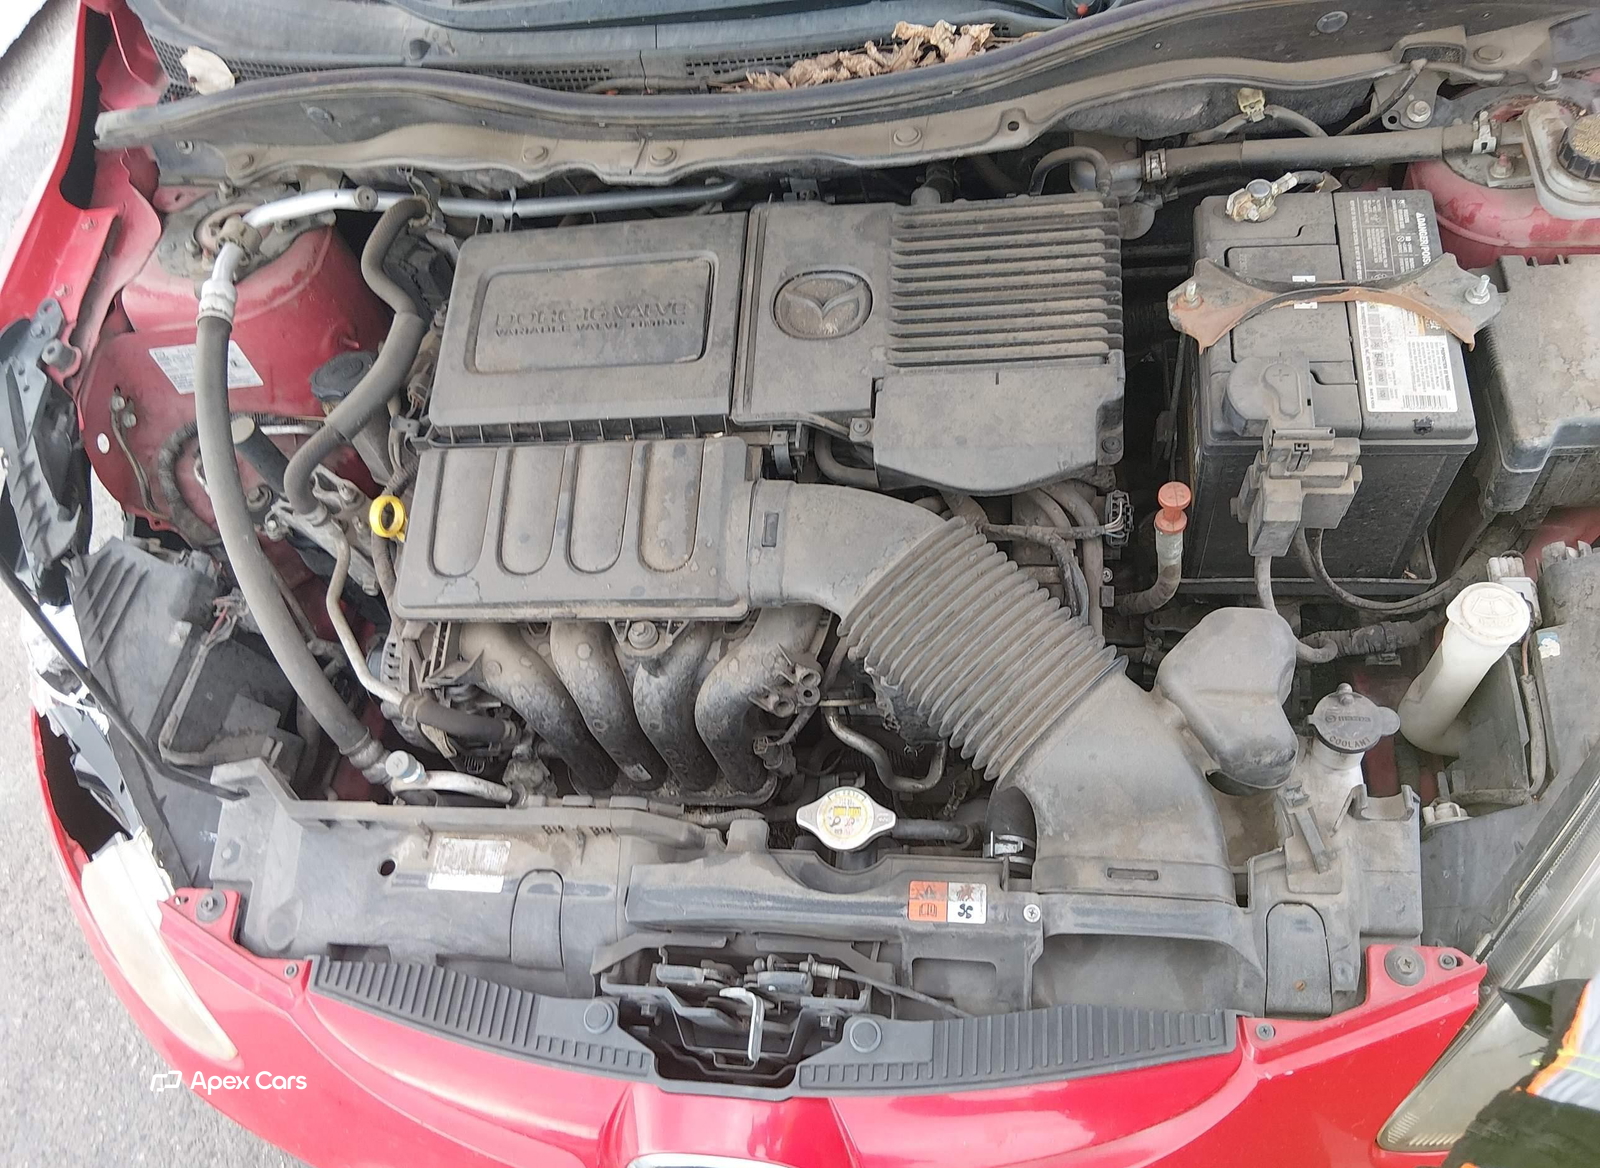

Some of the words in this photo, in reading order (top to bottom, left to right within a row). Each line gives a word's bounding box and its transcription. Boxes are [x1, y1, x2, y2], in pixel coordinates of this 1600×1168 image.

[576, 320, 621, 332] VALVE
[628, 317, 686, 329] TIMING
[1329, 735, 1371, 748] COOLANT
